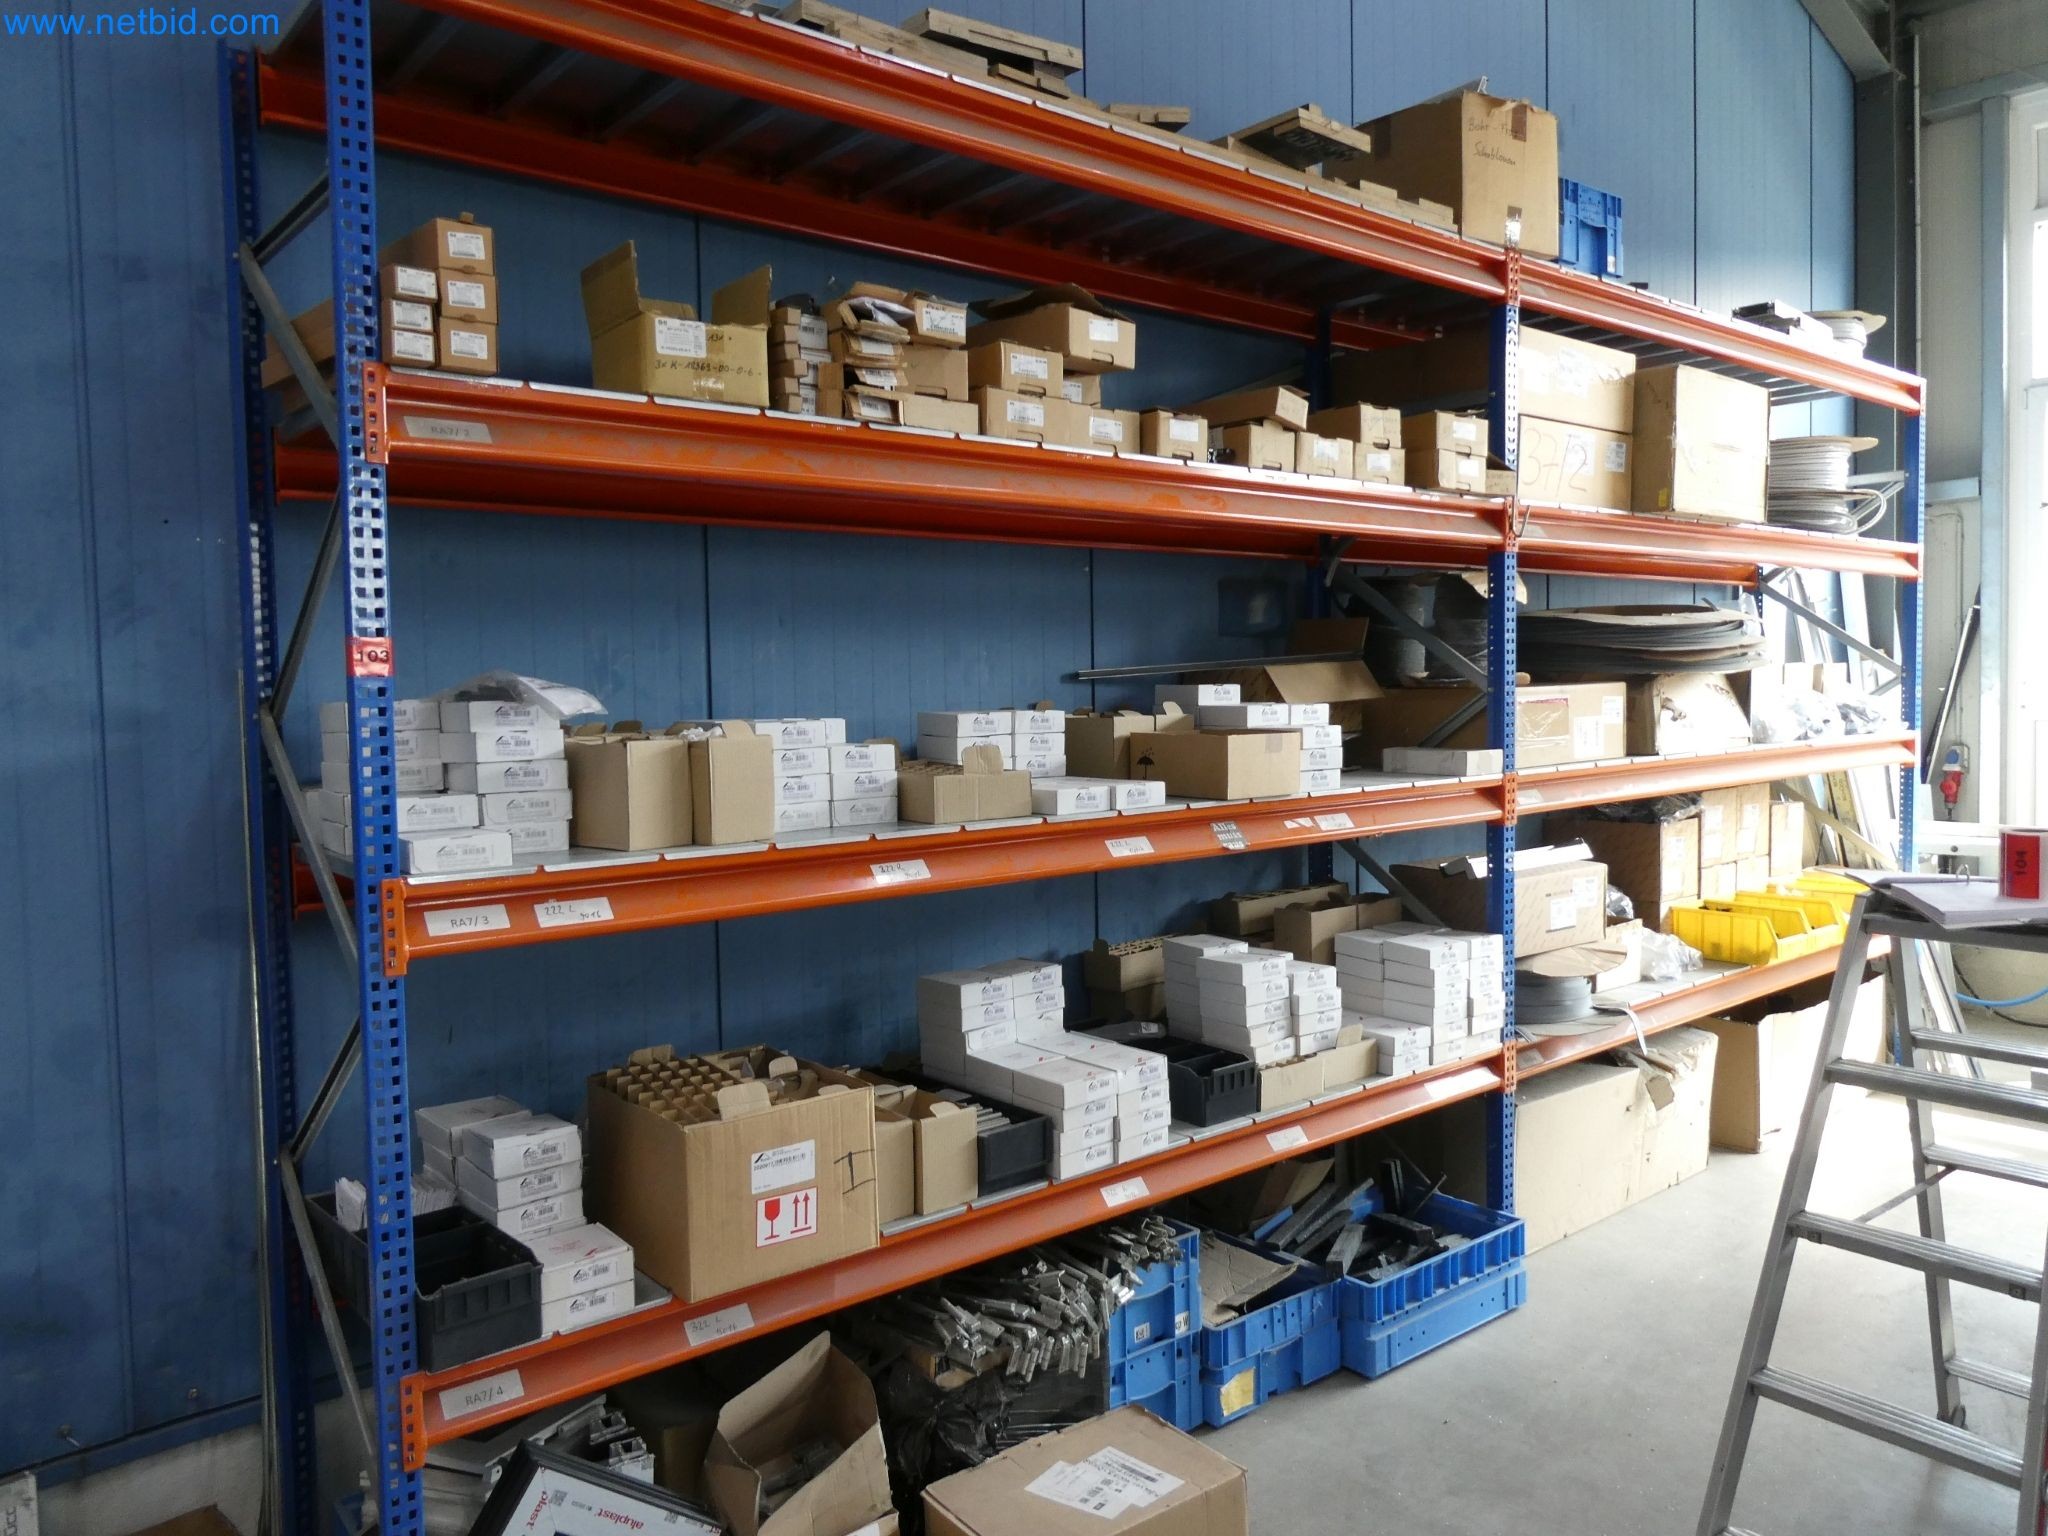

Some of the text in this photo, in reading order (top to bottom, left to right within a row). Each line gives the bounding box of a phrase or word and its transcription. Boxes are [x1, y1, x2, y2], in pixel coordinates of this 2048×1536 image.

[356, 650, 390, 663] 103
[544, 904, 563, 916] 222
[595, 1507, 645, 1530] aluplast
